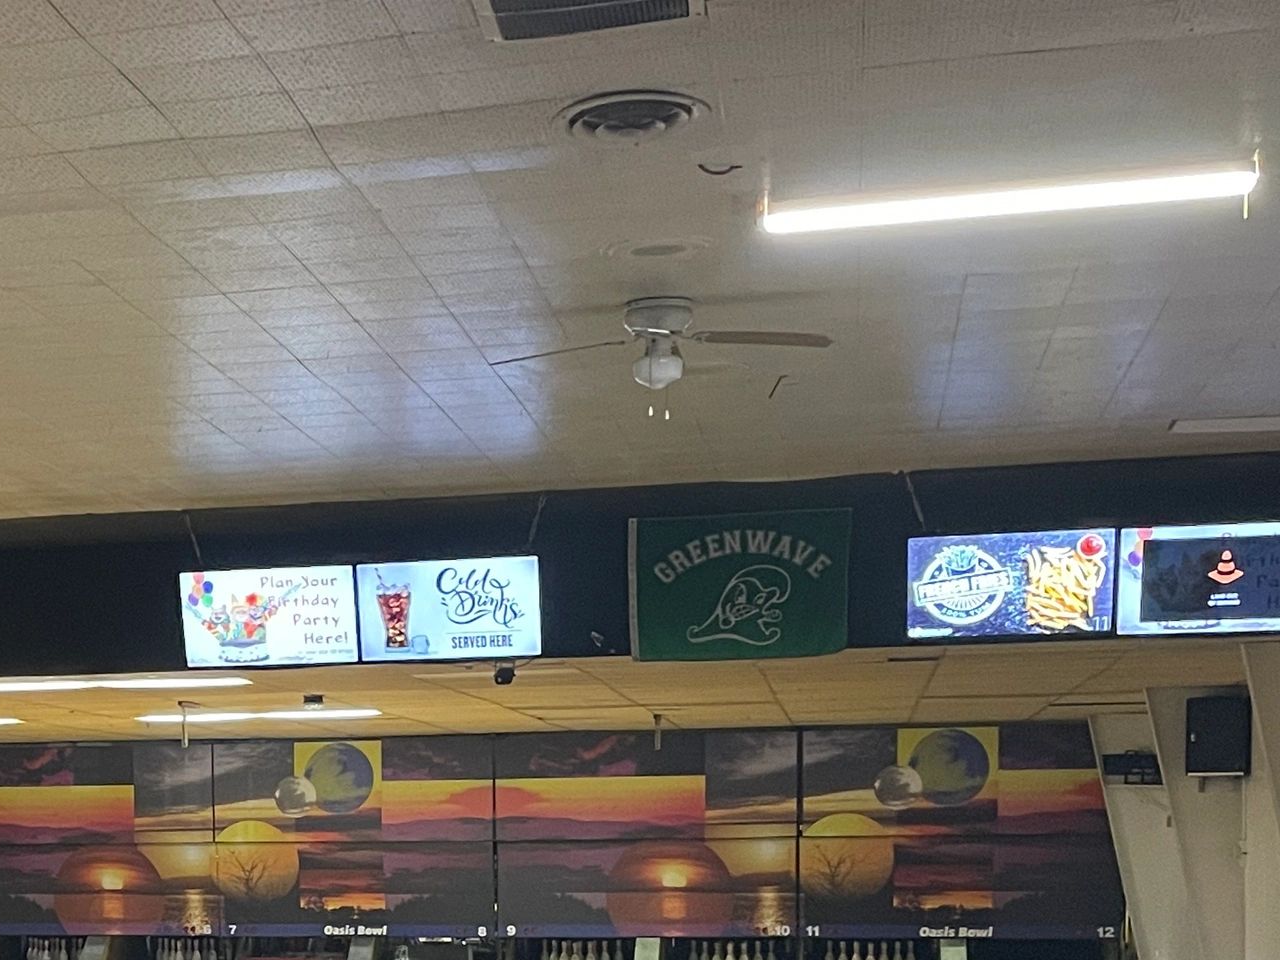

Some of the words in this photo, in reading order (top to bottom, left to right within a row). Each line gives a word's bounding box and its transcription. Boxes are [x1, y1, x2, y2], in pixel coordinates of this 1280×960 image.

[653, 529, 833, 583] GREENWAVE
[260, 576, 293, 589] Plan
[301, 575, 338, 589] Your
[436, 567, 495, 595] Cold
[446, 584, 521, 628] Drinks
[293, 613, 340, 628] Party
[304, 631, 349, 645] Here!
[451, 635, 488, 649] SERVED
[489, 634, 514, 648] HERE
[228, 924, 237, 935] 7
[323, 924, 355, 936] Oasis
[357, 925, 388, 936] Bowl
[477, 926, 487, 937] 8
[506, 925, 516, 937] 9
[774, 925, 791, 936] 10
[805, 925, 820, 937] 11
[919, 926, 956, 938] Oasis
[958, 926, 993, 938] Bowl
[1096, 926, 1116, 938] 12
